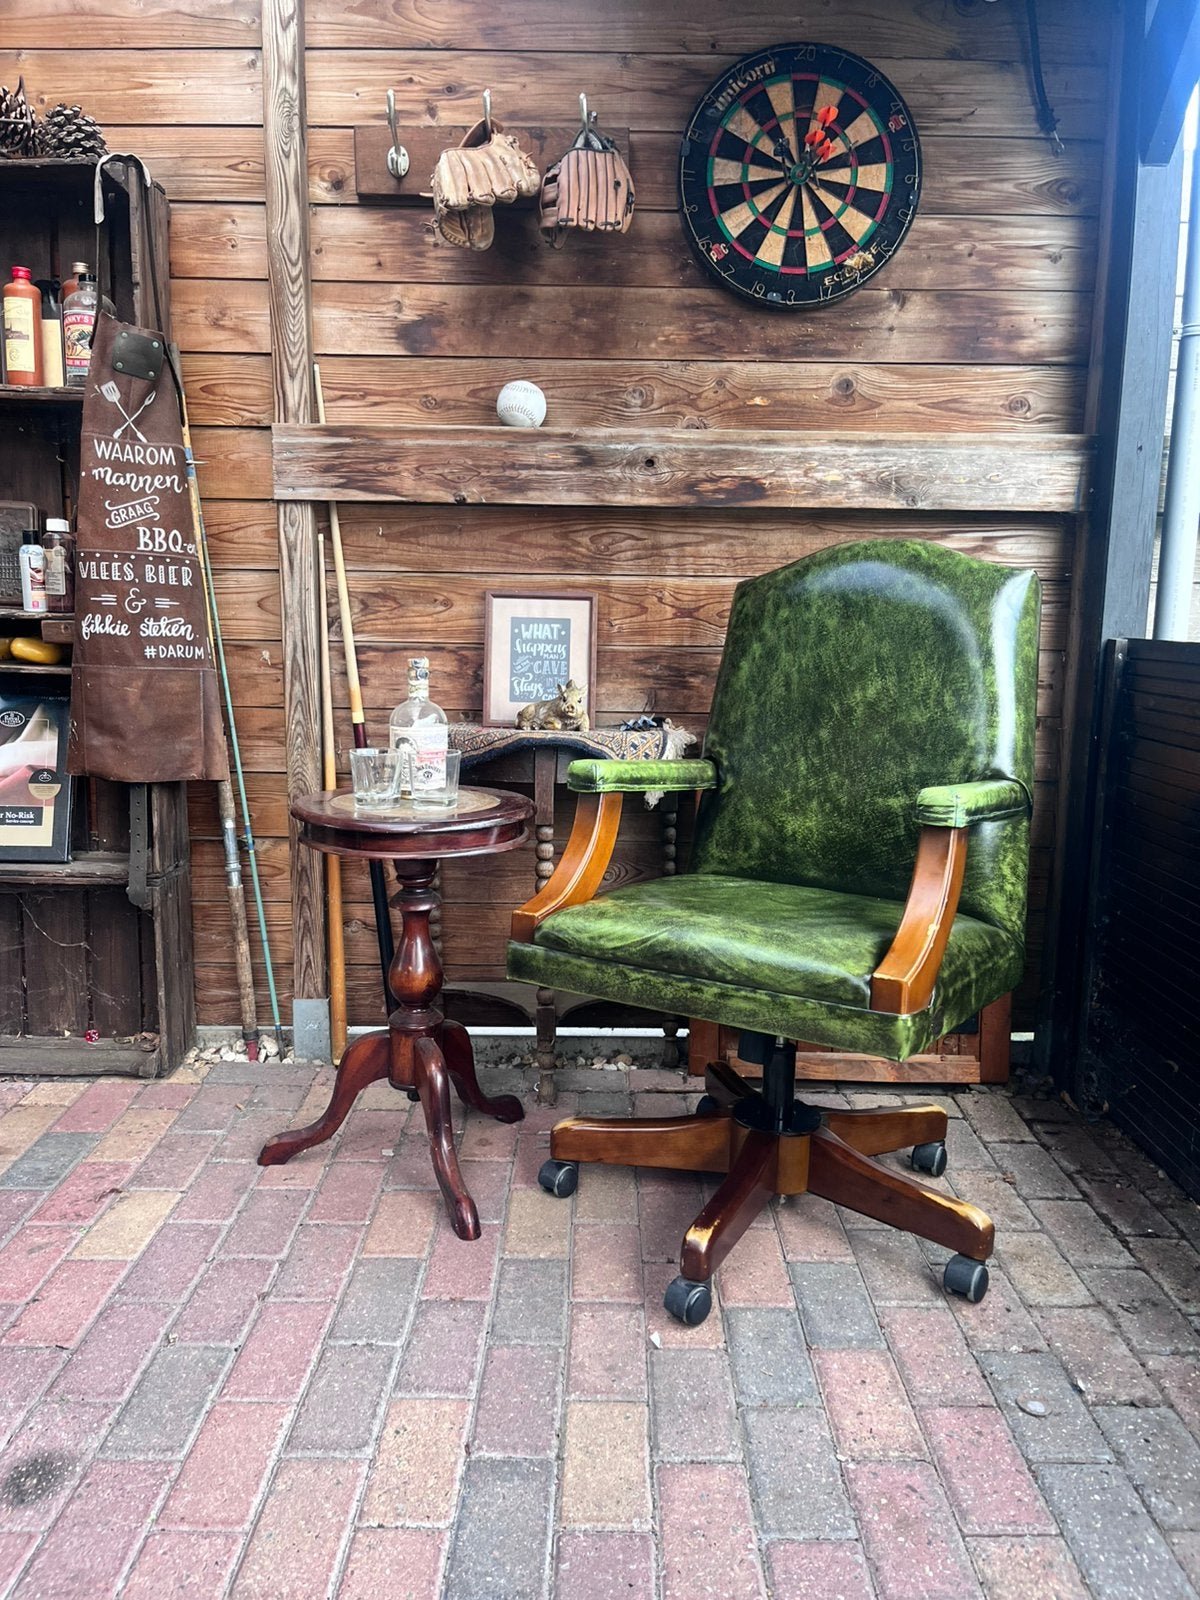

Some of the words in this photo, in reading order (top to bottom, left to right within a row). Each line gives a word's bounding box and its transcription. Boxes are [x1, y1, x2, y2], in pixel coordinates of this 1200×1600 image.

[794, 45, 816, 61] 20
[864, 72, 879, 88] 18
[901, 138, 918, 152] 13
[684, 204, 698, 214] 8
[897, 208, 912, 226] 10
[878, 240, 893, 259] 15
[722, 264, 735, 276] 7
[824, 241, 880, 287] ECLE
[750, 281, 766, 297] 19
[787, 289, 796, 305] 3
[817, 285, 833, 300] 17
[93, 438, 176, 466] WAAROM
[91, 466, 183, 494] mannen
[110, 502, 154, 524] GRAAG
[78, 561, 139, 584] VLEES,
[145, 564, 193, 587] BIER
[124, 587, 147, 613] &
[81, 613, 131, 641] fikkie
[521, 623, 561, 641] WHAT
[144, 637, 212, 660] #DARUM!
[513, 638, 567, 660] happens
[533, 660, 568, 676] CAVE
[5, 811, 35, 819] No-Risk
